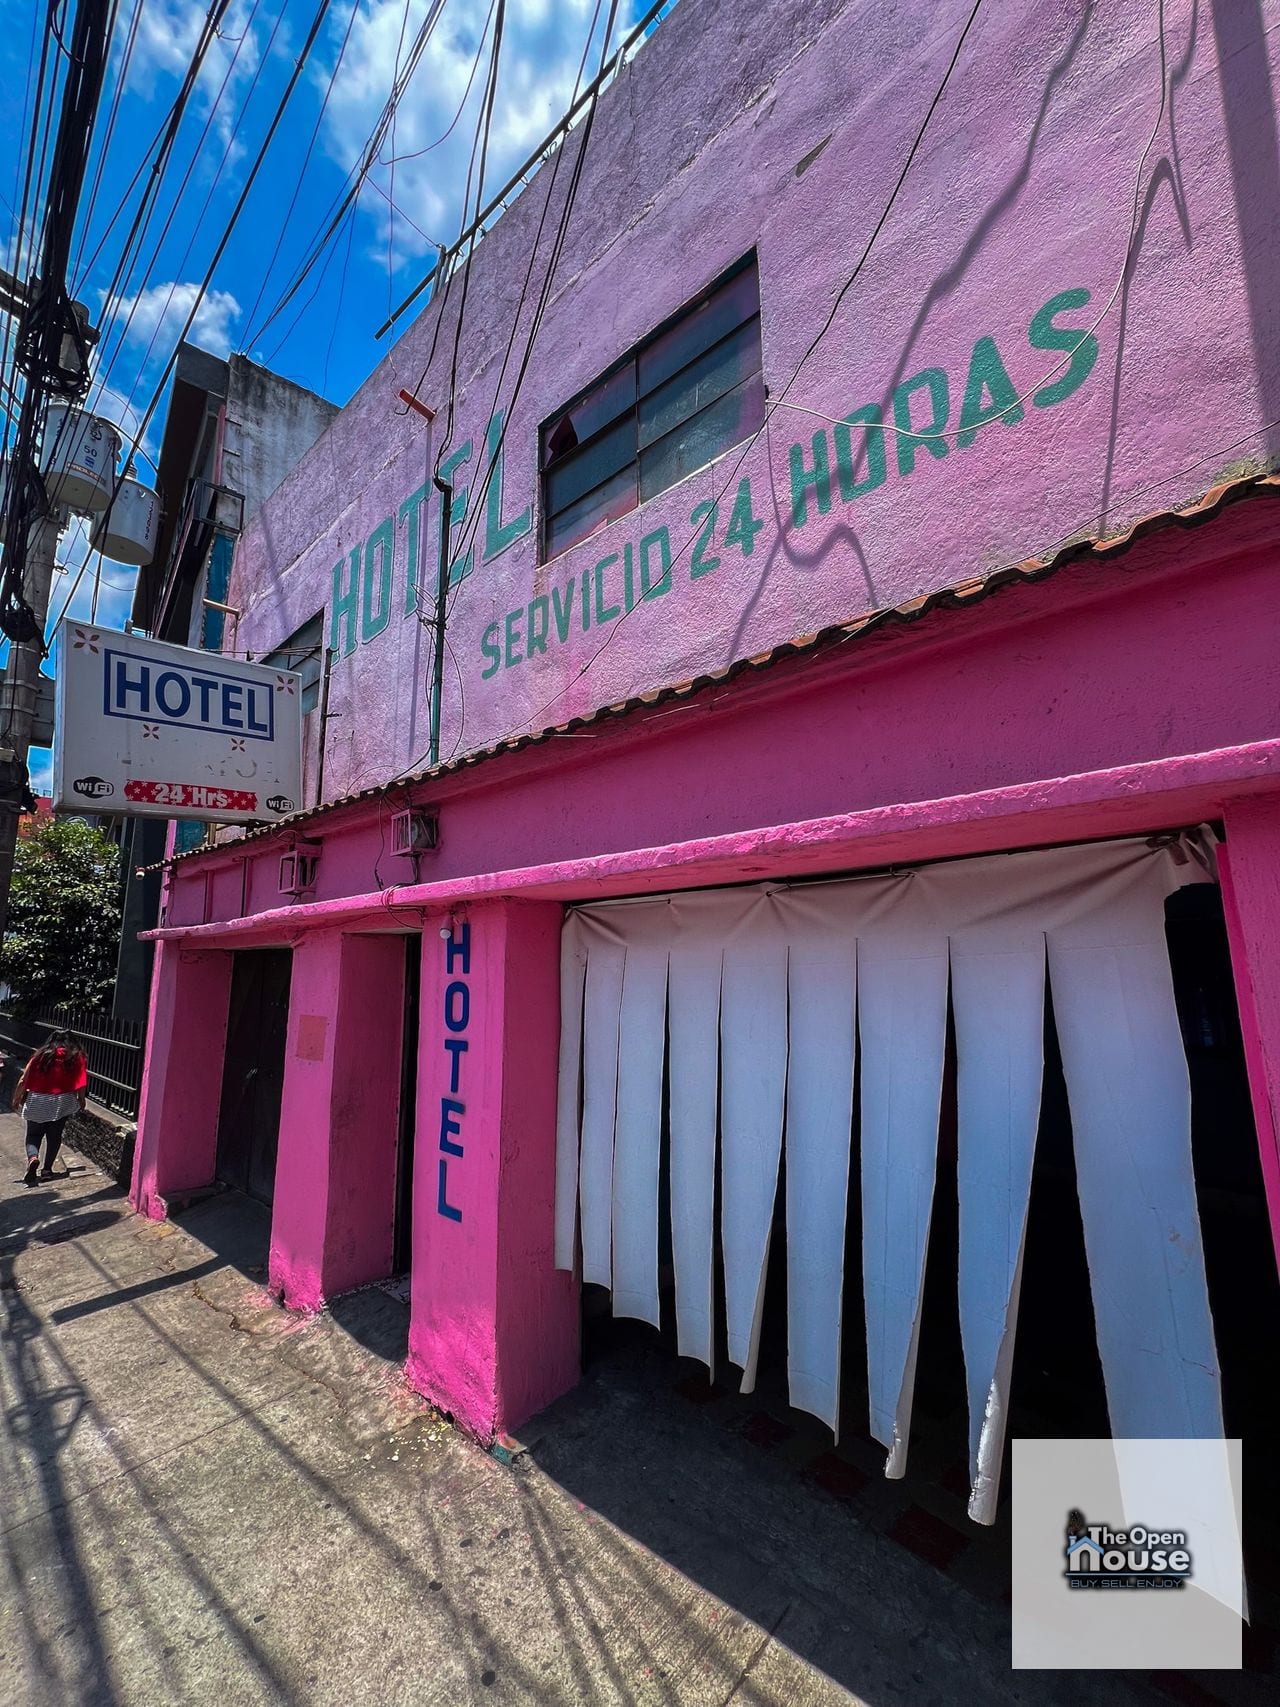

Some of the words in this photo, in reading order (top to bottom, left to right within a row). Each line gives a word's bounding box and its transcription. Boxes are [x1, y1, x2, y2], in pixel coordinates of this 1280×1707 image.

[329, 408, 533, 664] HOTEL
[481, 525, 673, 681] SERVICIO
[690, 477, 765, 580] 24
[788, 287, 1099, 529] HORAS
[116, 661, 268, 733] HOTEL
[154, 783, 185, 804] 24
[192, 786, 228, 808] Hrs
[437, 922, 471, 1224] HOTEL
